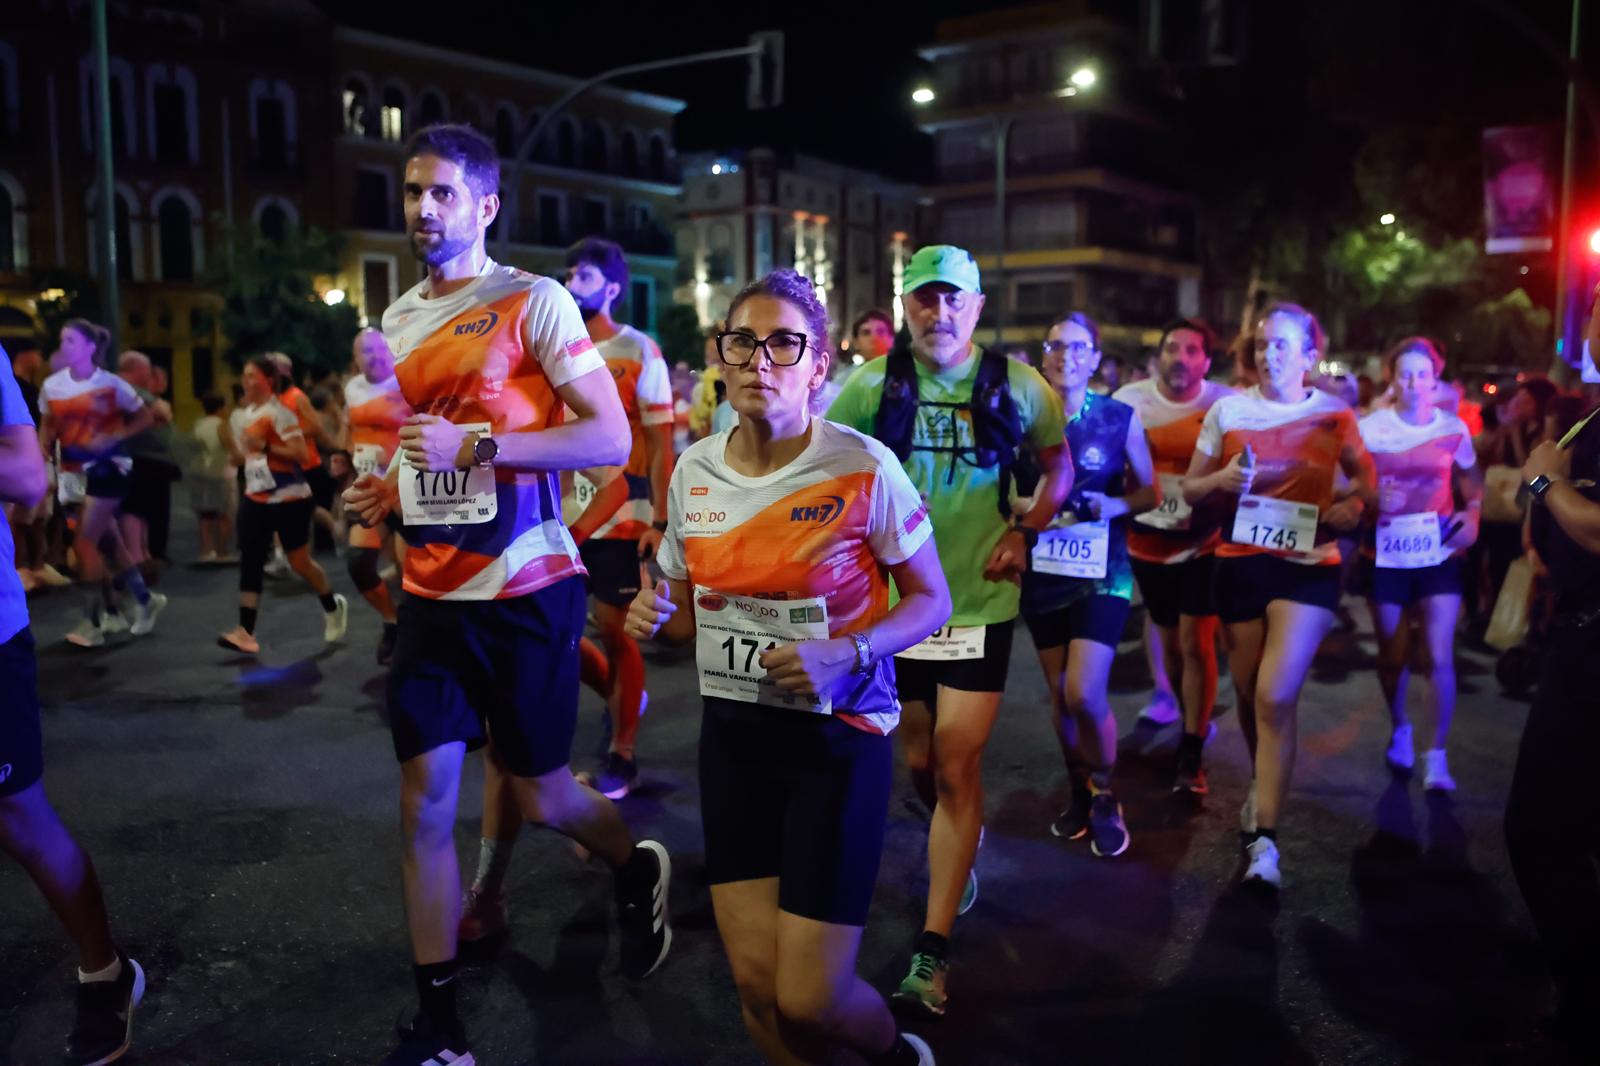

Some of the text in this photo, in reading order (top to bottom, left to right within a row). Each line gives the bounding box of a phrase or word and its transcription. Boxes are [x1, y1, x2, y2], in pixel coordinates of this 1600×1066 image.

[415, 467, 471, 497] 1707
[1047, 536, 1092, 560] 1705
[1250, 524, 1298, 551] 1745
[704, 669, 728, 680] MARÍA
[728, 673, 761, 684] VANESSA
